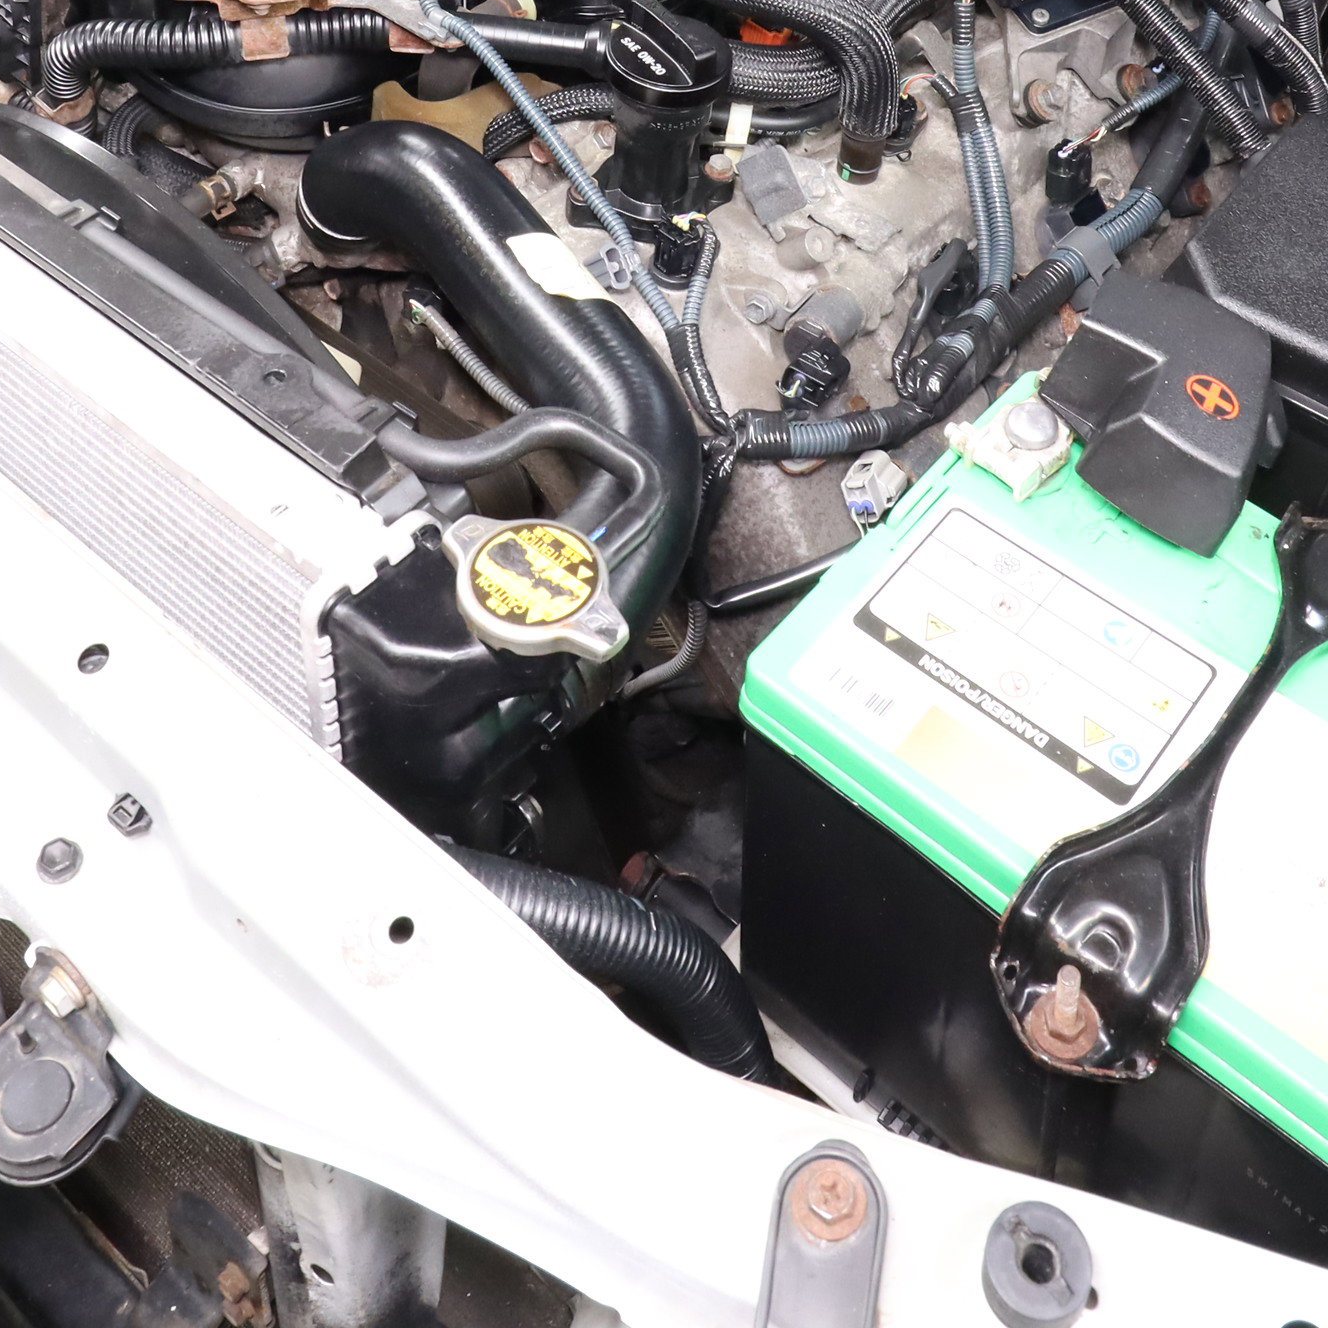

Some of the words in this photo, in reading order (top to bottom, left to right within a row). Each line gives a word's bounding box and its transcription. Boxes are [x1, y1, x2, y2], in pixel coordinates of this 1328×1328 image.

[620, 36, 642, 53] SAE
[637, 51, 667, 76] 0W-20
[517, 528, 572, 568] ATTENTION
[475, 575, 527, 614] CAUTION
[917, 653, 1050, 749] DANGER/POISON
